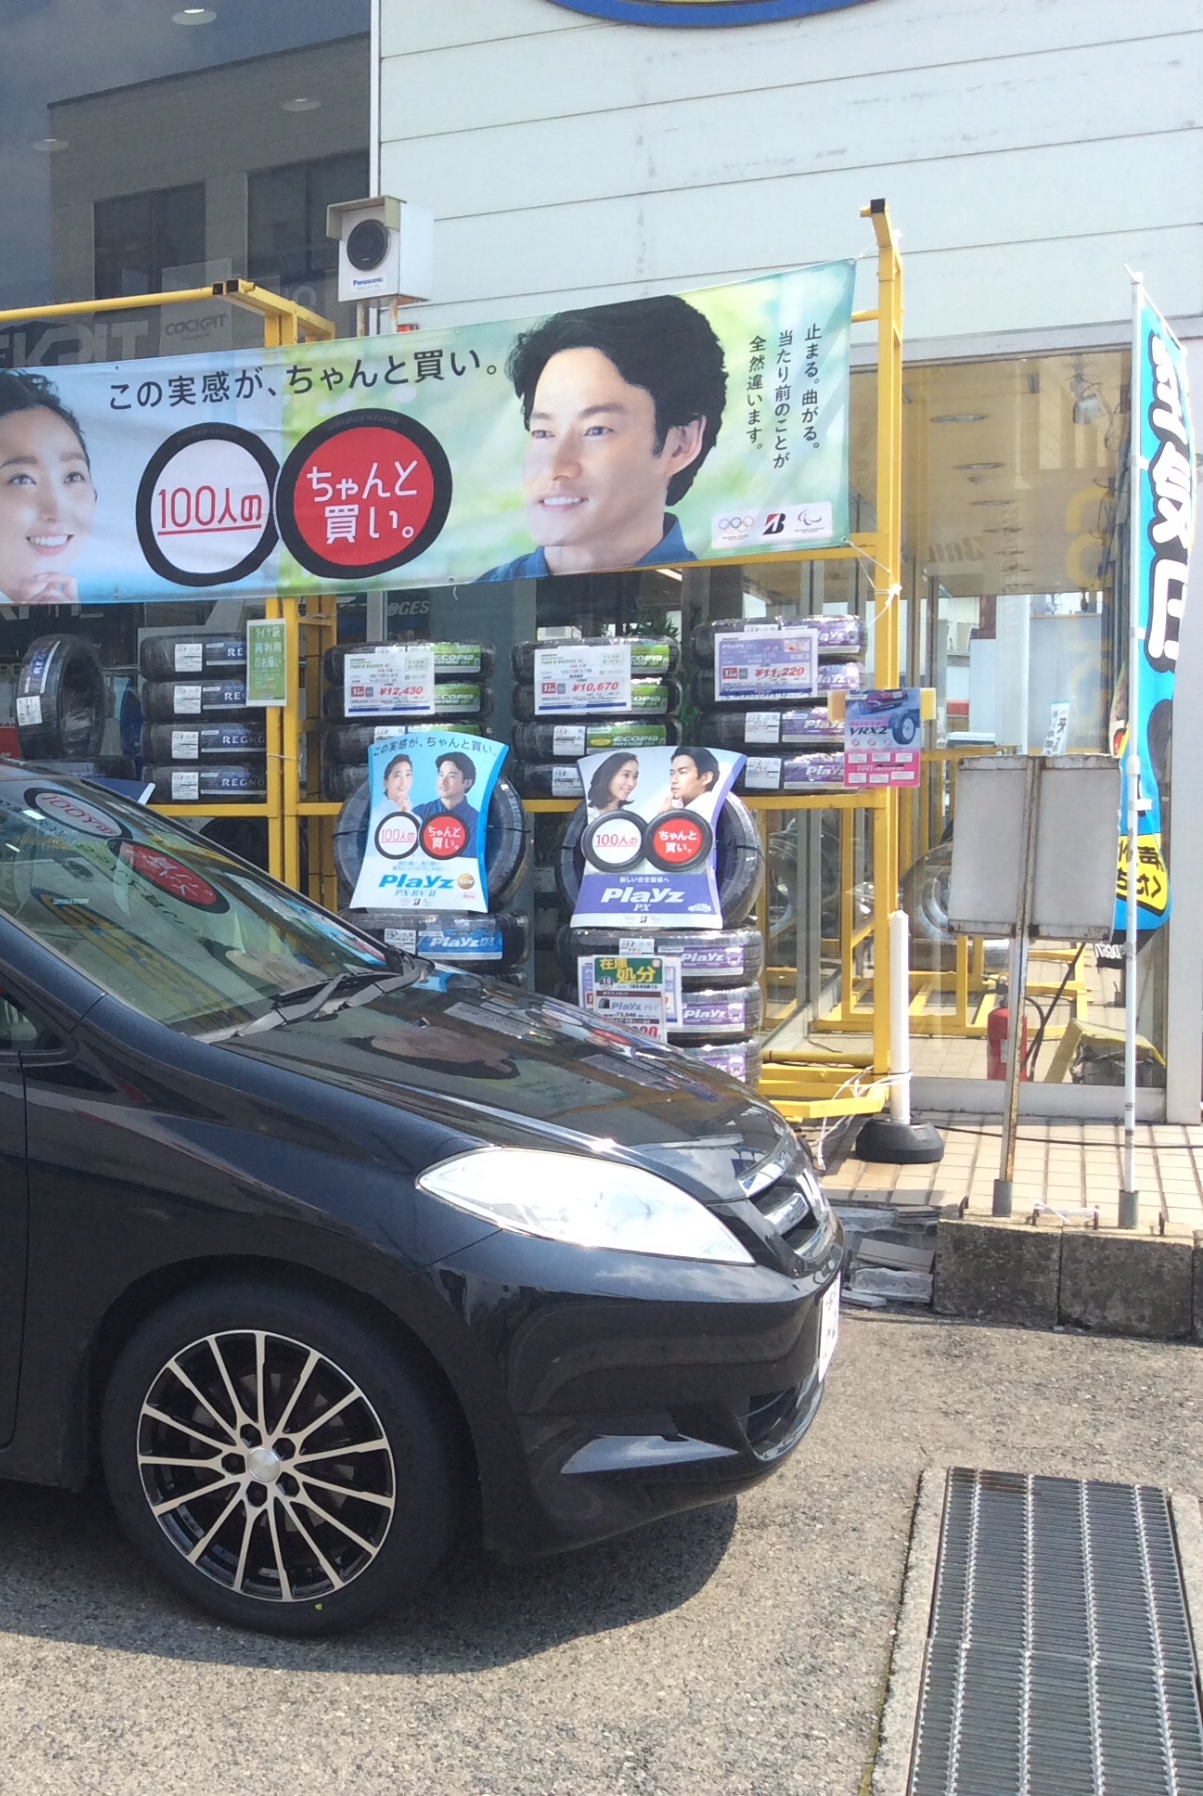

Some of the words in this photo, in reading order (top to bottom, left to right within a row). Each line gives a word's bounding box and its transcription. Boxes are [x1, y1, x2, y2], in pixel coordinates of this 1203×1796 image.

[746, 335, 767, 450] 全然違います。
[773, 330, 793, 469] 当たり前のことが
[306, 459, 418, 502] ちゃんと
[158, 485, 262, 528] 100人の
[324, 503, 415, 544] 買い。
[755, 666, 805, 679] ¥11,220
[379, 686, 424, 697] ¥12,430
[572, 681, 619, 693] ¥10,670
[849, 726, 888, 736] VRX2
[223, 735, 265, 745] REGNO
[222, 778, 265, 787] REGNO
[381, 829, 415, 841] 100人の
[428, 826, 461, 838] ちゃんと
[659, 831, 697, 842] ちゃんと
[596, 834, 638, 846] 100人の
[633, 904, 651, 912] PX
